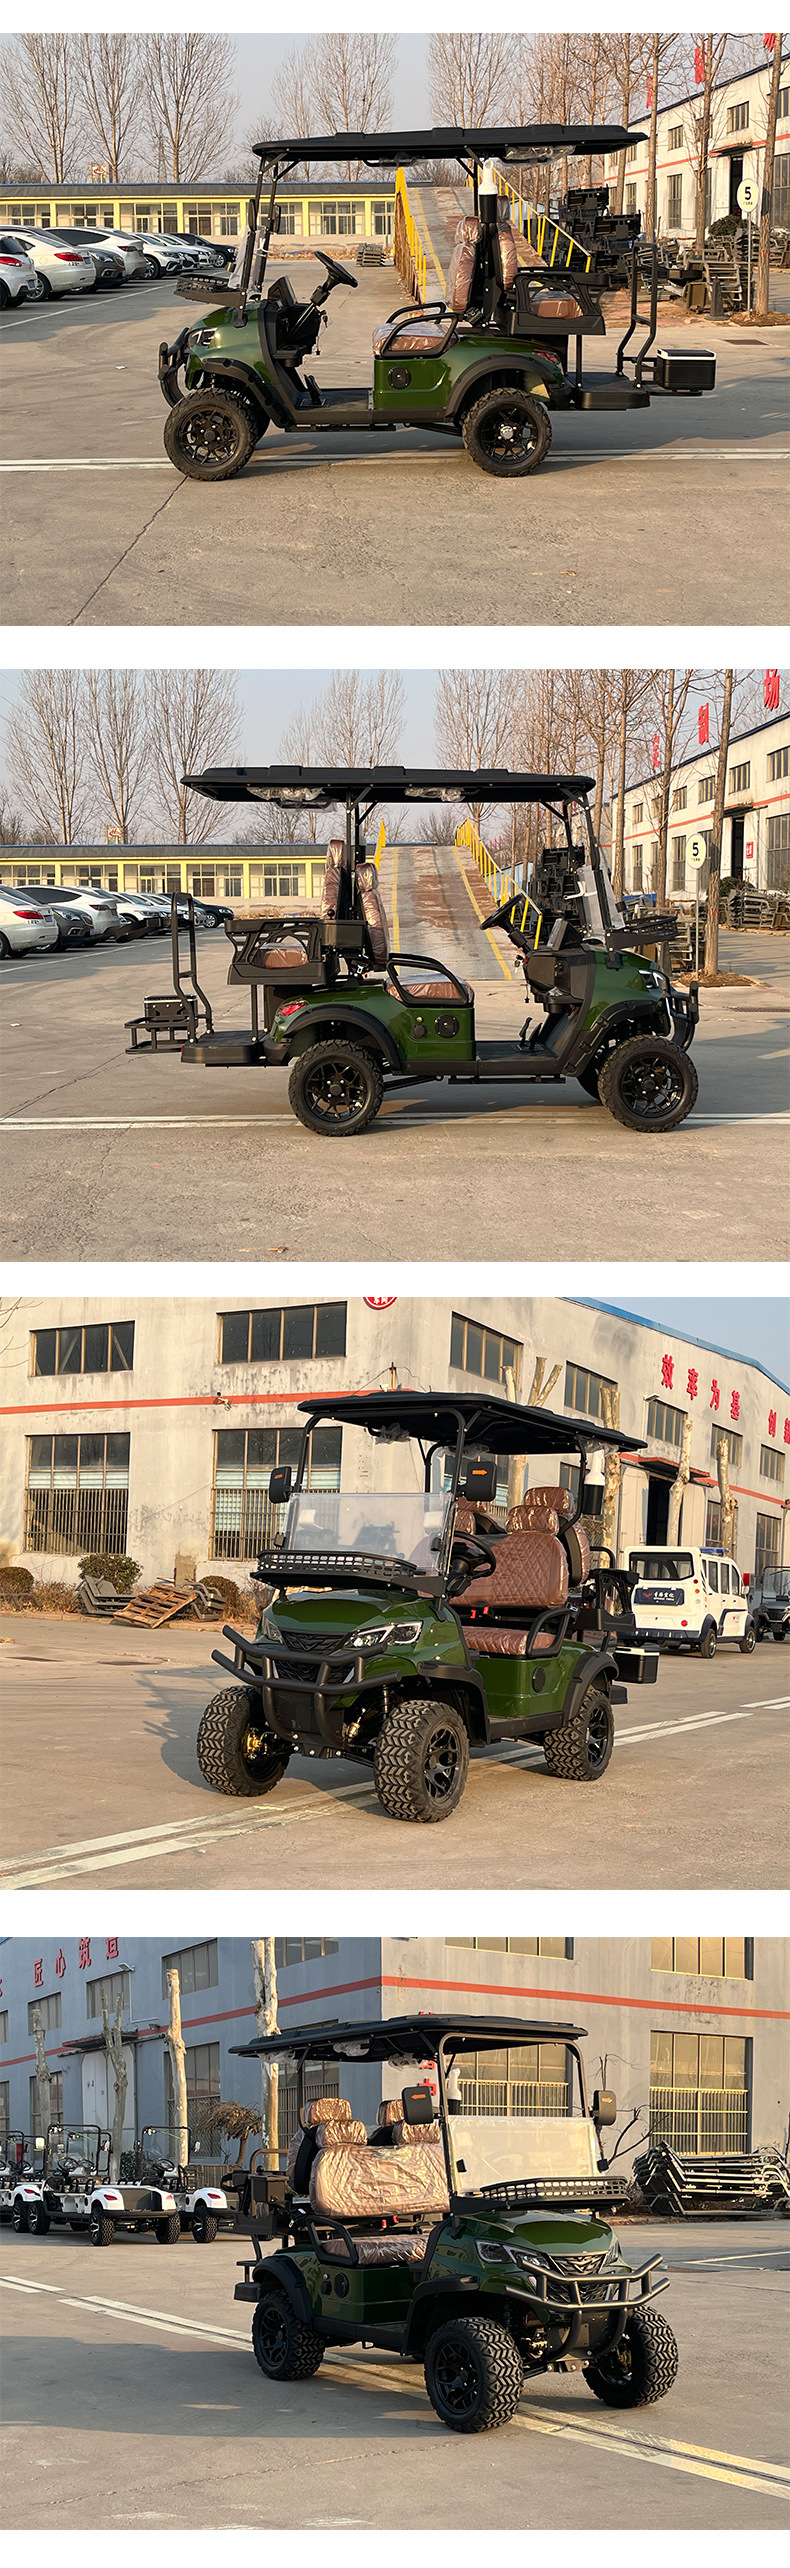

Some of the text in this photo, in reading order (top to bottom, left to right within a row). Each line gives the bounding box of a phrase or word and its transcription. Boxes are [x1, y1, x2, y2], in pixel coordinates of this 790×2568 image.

[744, 186, 752, 200] 5
[692, 842, 700, 857] 5
[661, 1354, 740, 1421] 效率为基
